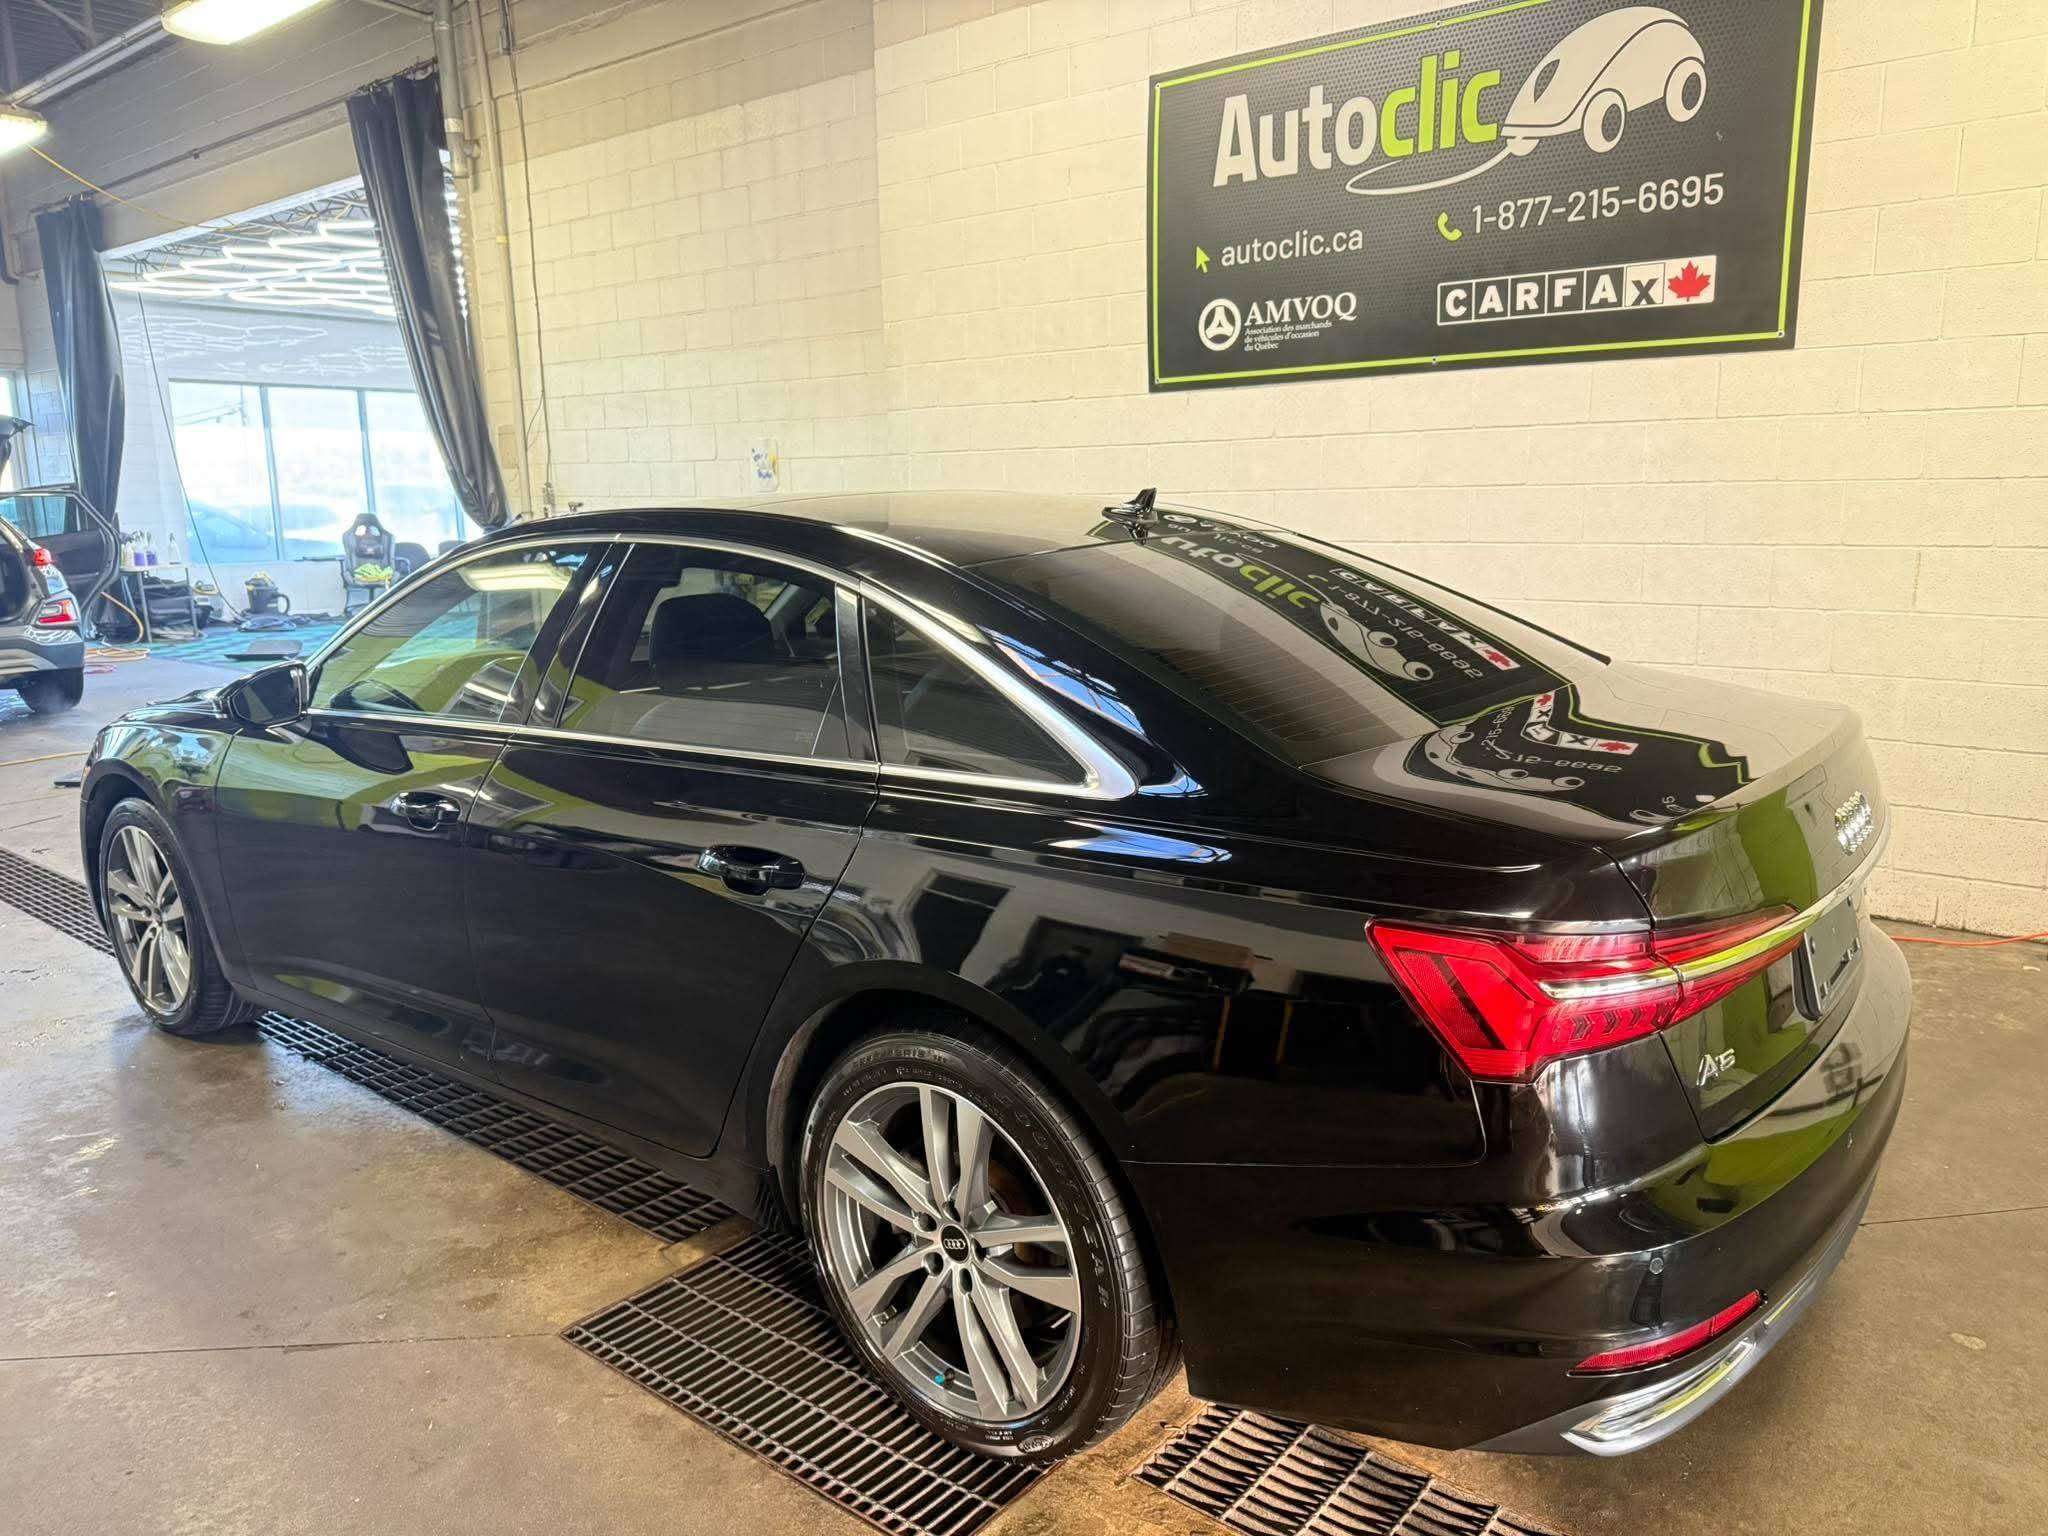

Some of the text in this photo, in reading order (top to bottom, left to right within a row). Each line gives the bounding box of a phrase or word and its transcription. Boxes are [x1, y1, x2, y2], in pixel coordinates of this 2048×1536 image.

[1213, 49, 1501, 187] Autoclic
[1472, 172, 1725, 234] 1-877-215-6695
[1221, 229, 1364, 267] autoclic.ca
[1244, 292, 1358, 327] AMVOQ
[1444, 271, 1661, 318] CARFAX
[1244, 327, 1282, 337] Association
